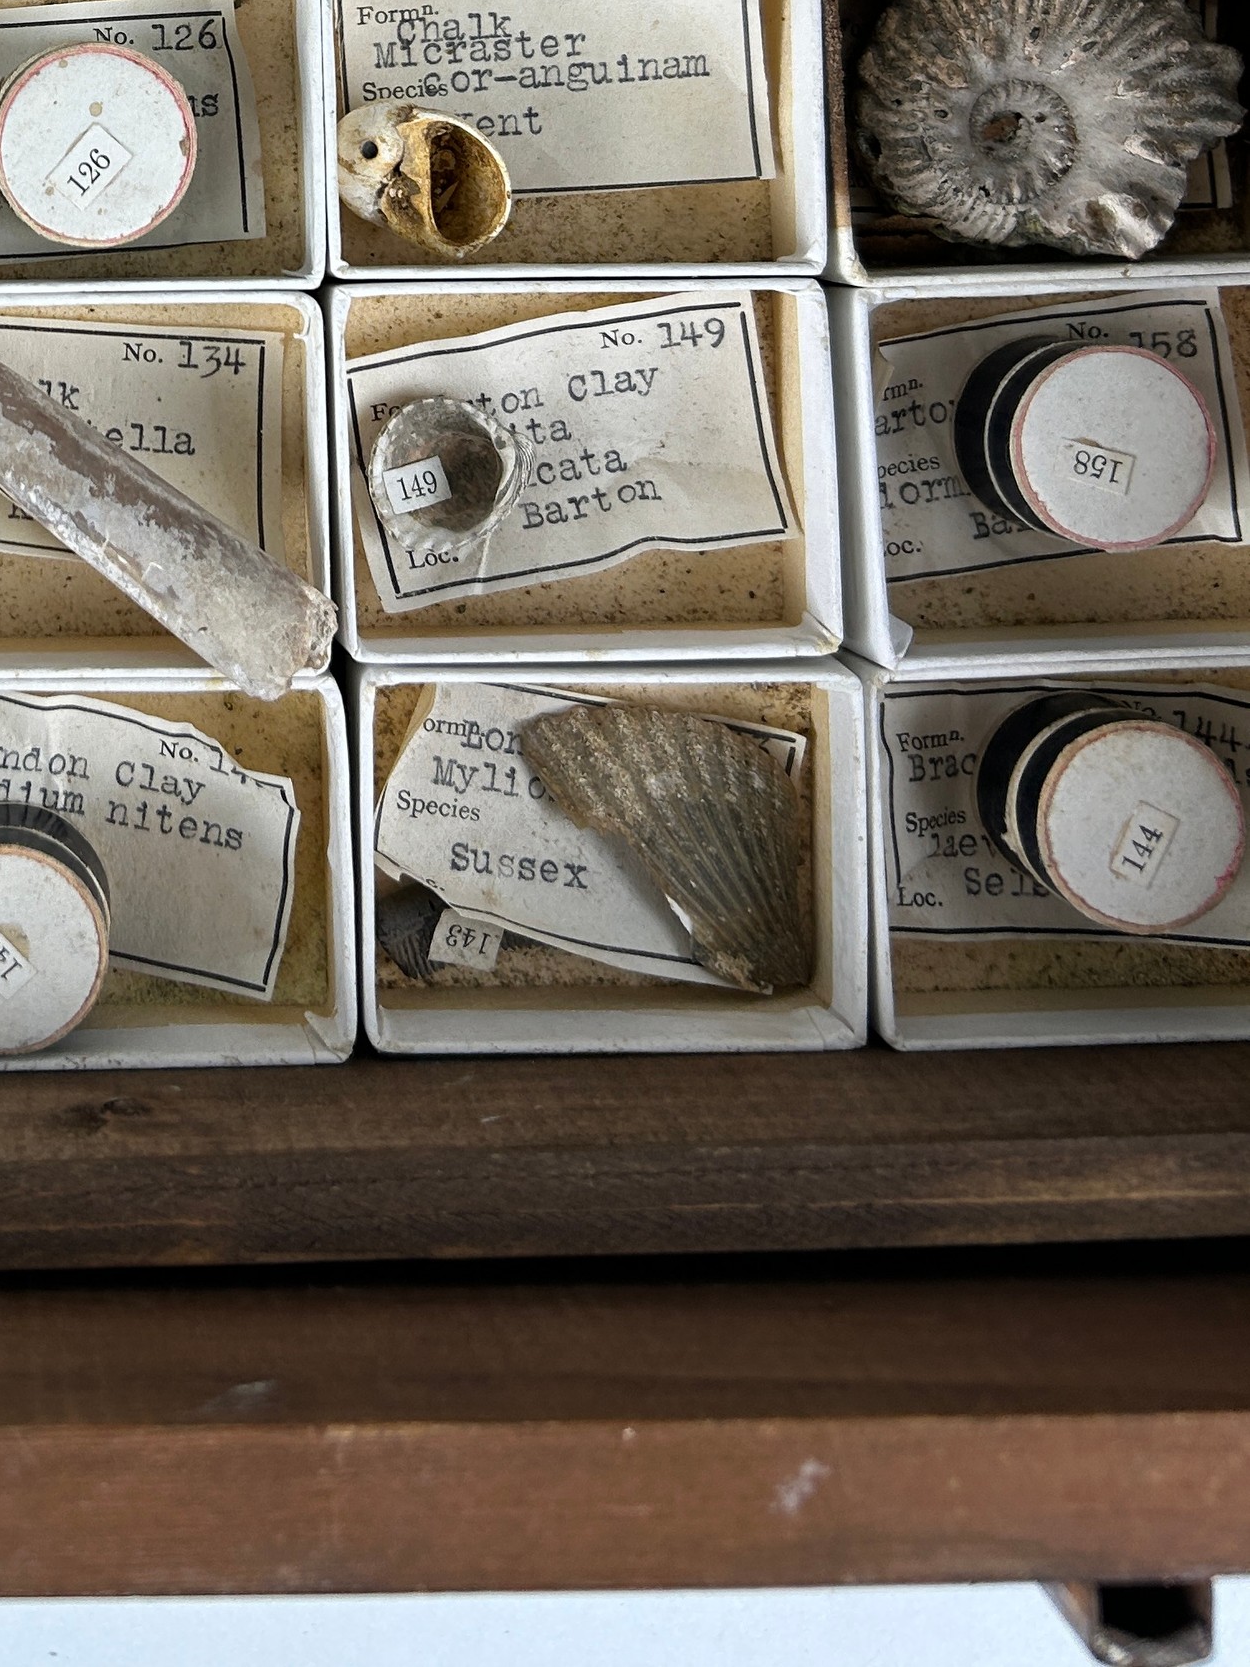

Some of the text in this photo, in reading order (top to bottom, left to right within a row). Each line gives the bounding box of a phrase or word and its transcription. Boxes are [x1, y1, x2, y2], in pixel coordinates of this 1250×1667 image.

[151, 20, 218, 51] 126
[396, 12, 512, 43] Chalk
[374, 31, 586, 69] Micraster
[66, 148, 112, 197] 126
[601, 317, 726, 350] No. 149
[122, 341, 246, 378] No. 134
[568, 366, 658, 402] Clay
[1073, 450, 1123, 484] 158
[396, 471, 438, 502] 149
[519, 477, 663, 530] Barton
[407, 548, 459, 570] Loc.
[885, 538, 922, 556] oc.
[158, 739, 199, 762] No.
[116, 760, 206, 806] Clay
[396, 790, 481, 821] Species
[905, 807, 966, 836] Species
[106, 799, 243, 850] nitens
[1122, 824, 1163, 872] 144
[451, 841, 590, 889] Sussex
[897, 885, 943, 907] Loc.
[445, 924, 492, 954] 143
